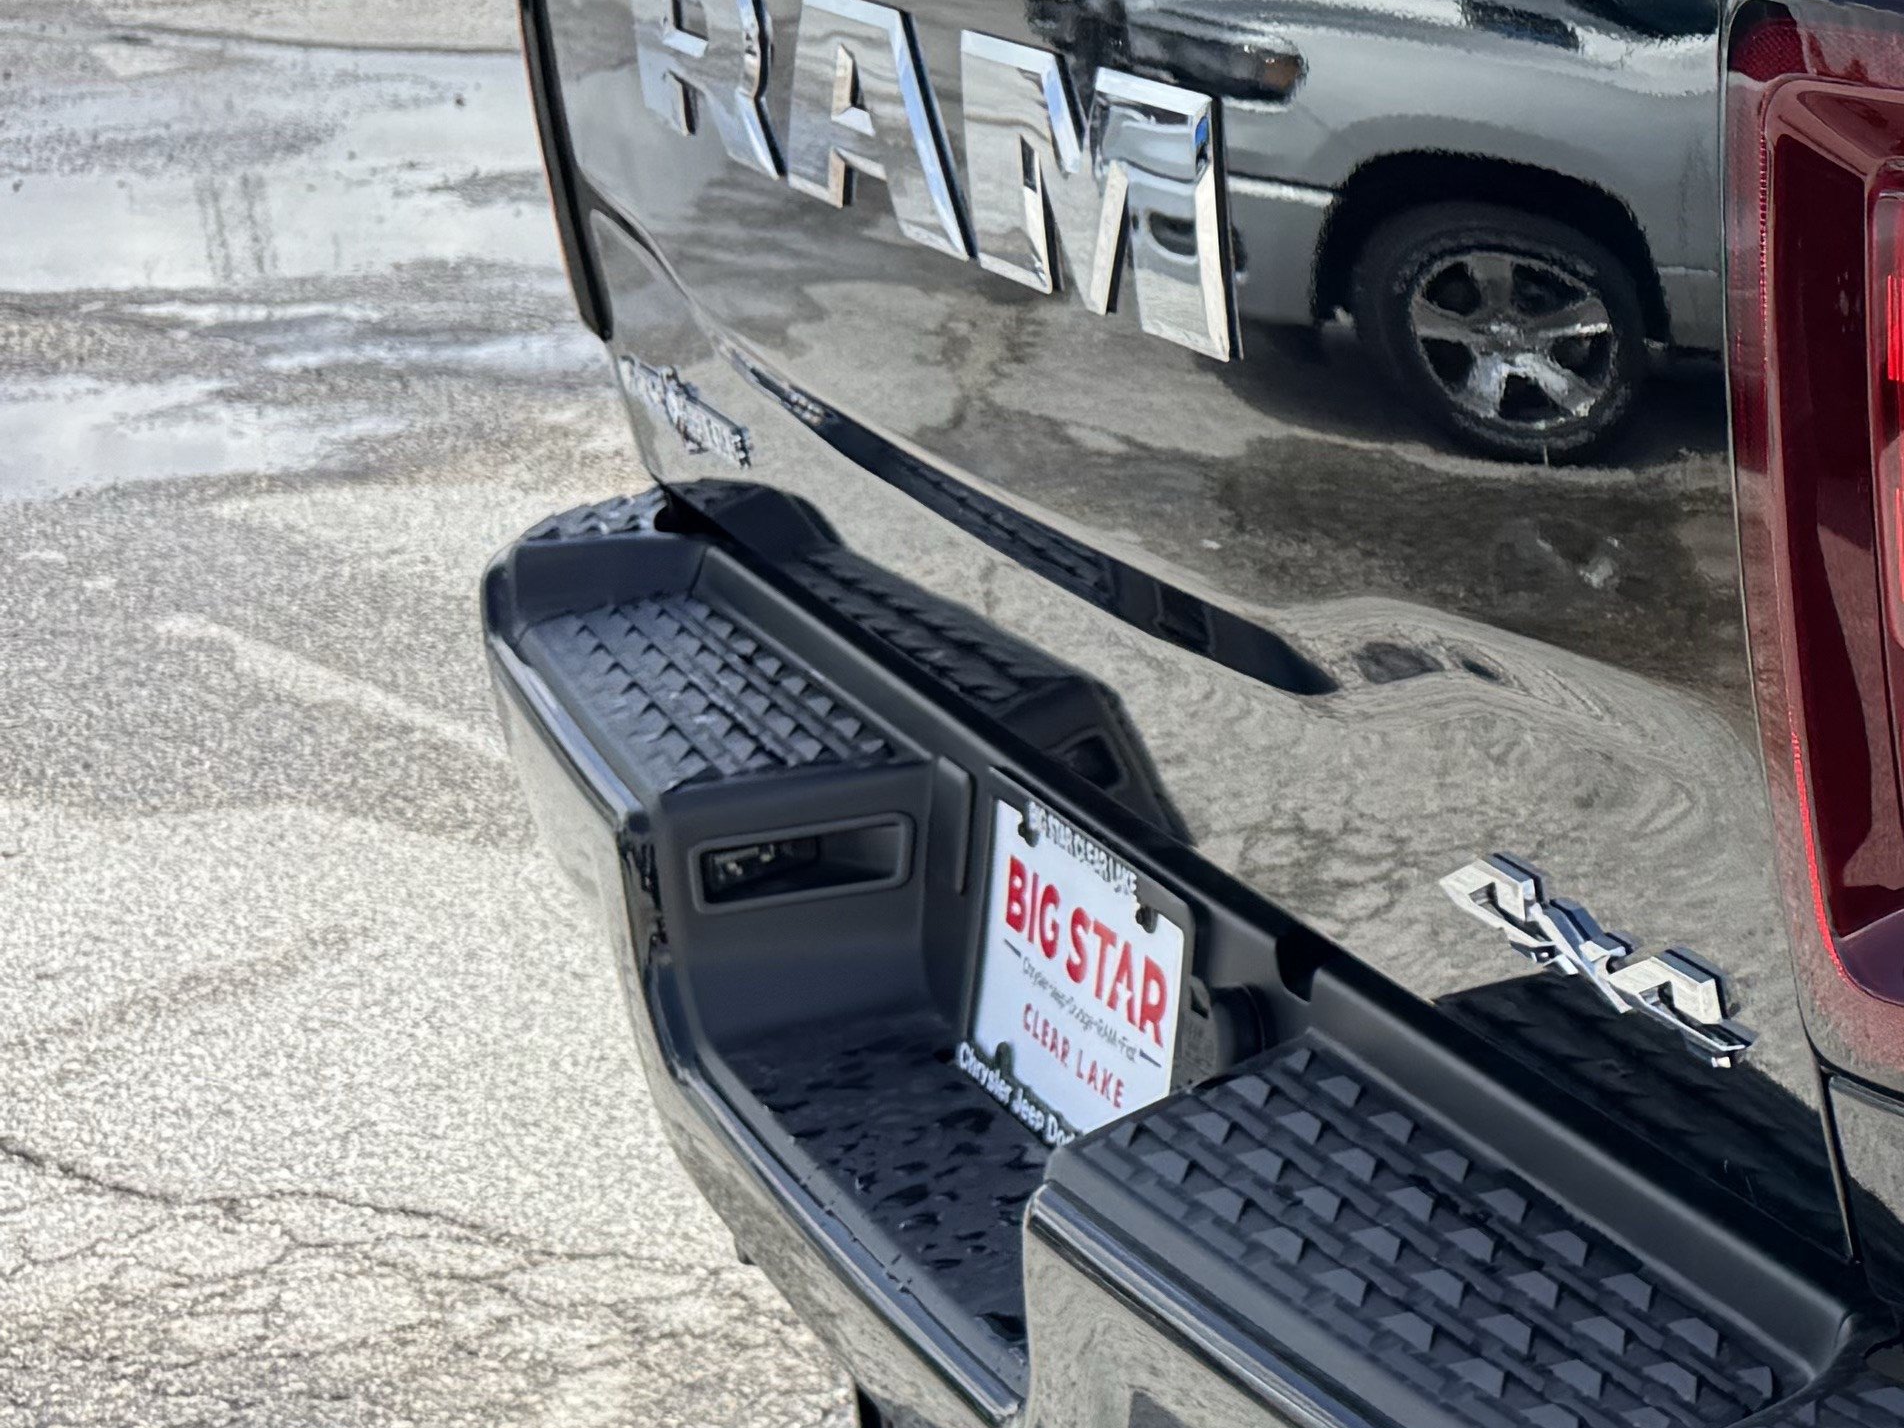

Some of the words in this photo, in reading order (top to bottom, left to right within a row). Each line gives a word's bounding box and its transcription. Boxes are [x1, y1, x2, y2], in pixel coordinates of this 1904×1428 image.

[1005, 853, 1061, 960] BIG
[1065, 906, 1168, 1049] STAR
[1022, 1002, 1071, 1069] CLEAR
[1075, 1048, 1126, 1110] LAKE
